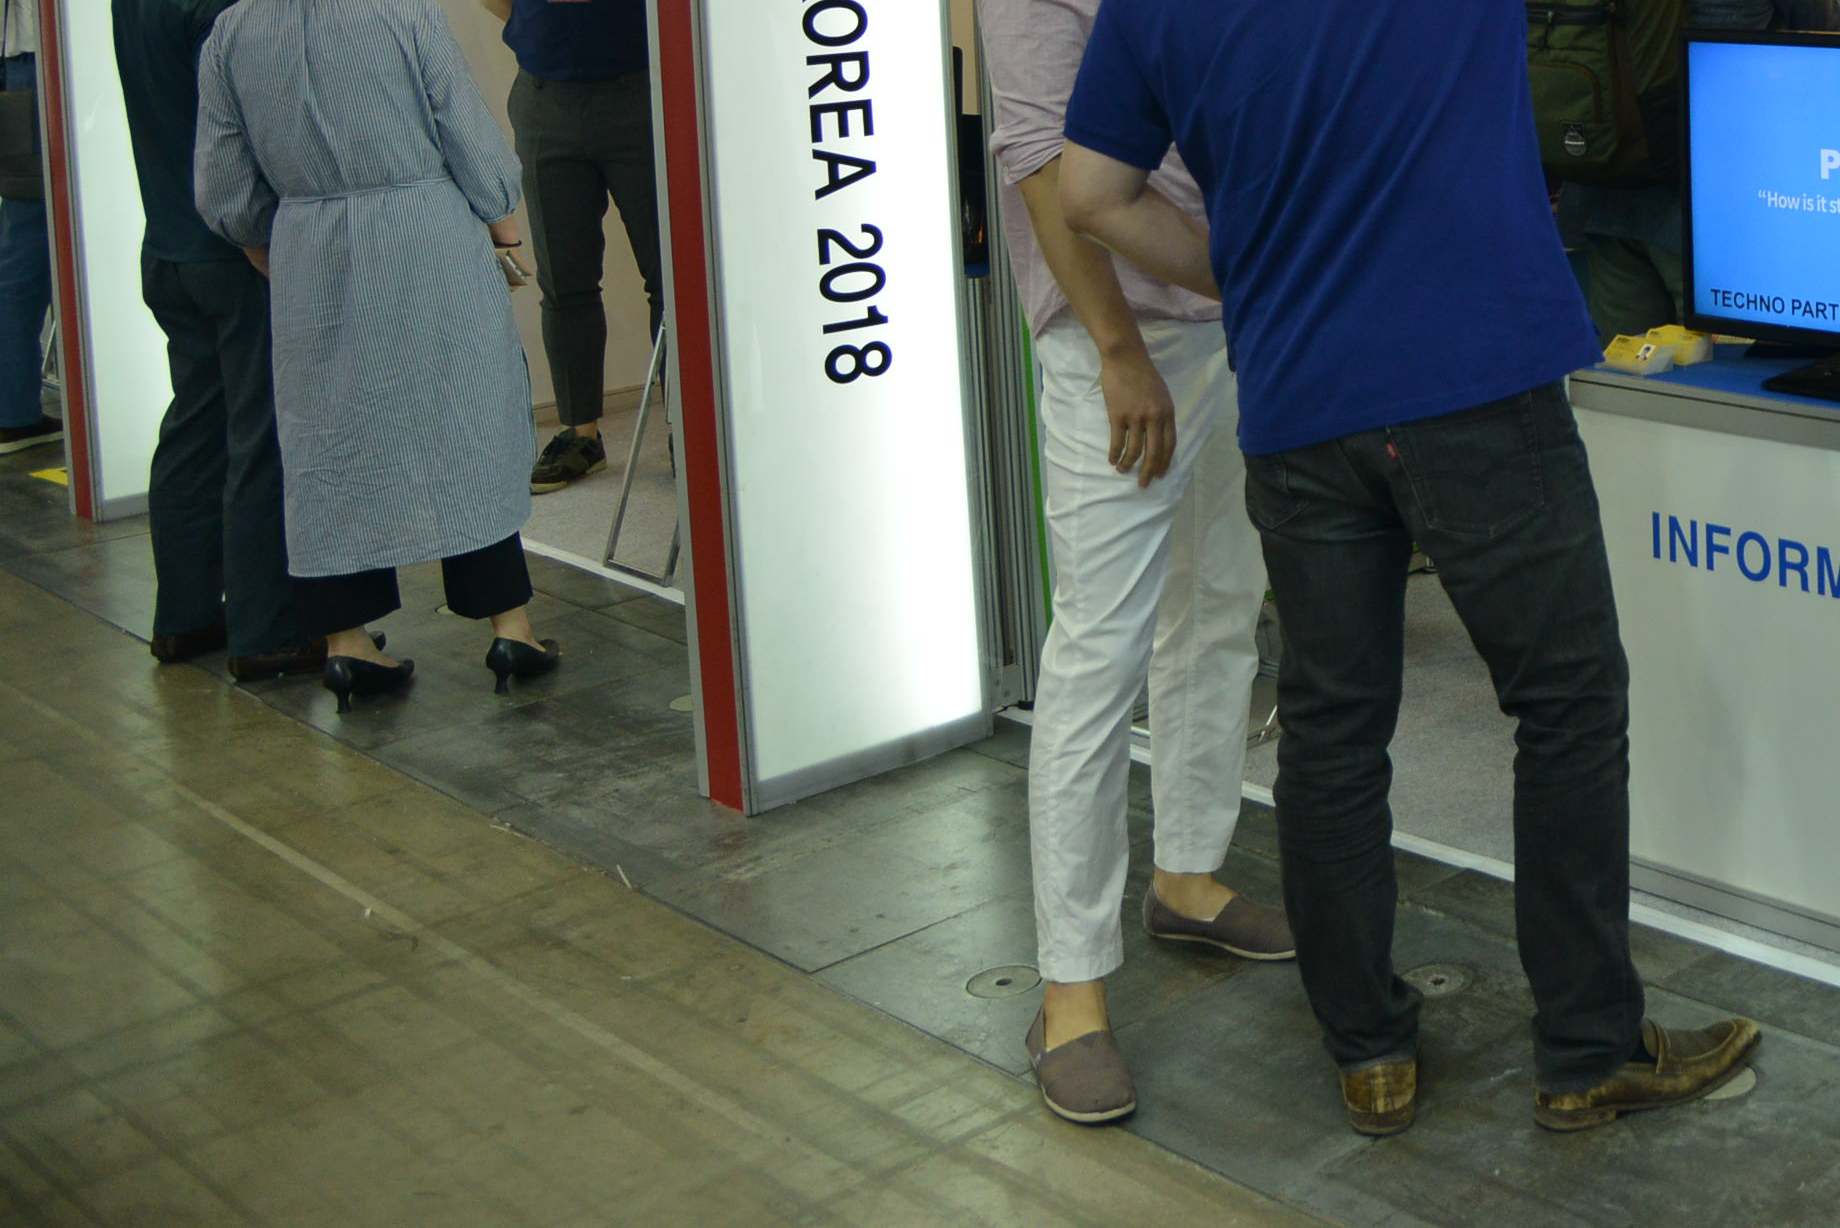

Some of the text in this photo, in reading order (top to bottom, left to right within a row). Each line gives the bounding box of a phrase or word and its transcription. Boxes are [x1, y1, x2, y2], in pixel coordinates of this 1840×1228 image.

[1802, 193, 1814, 212] is
[1816, 196, 1827, 214] it
[816, 222, 893, 386] 2018
[1711, 288, 1785, 315] TECHNO
